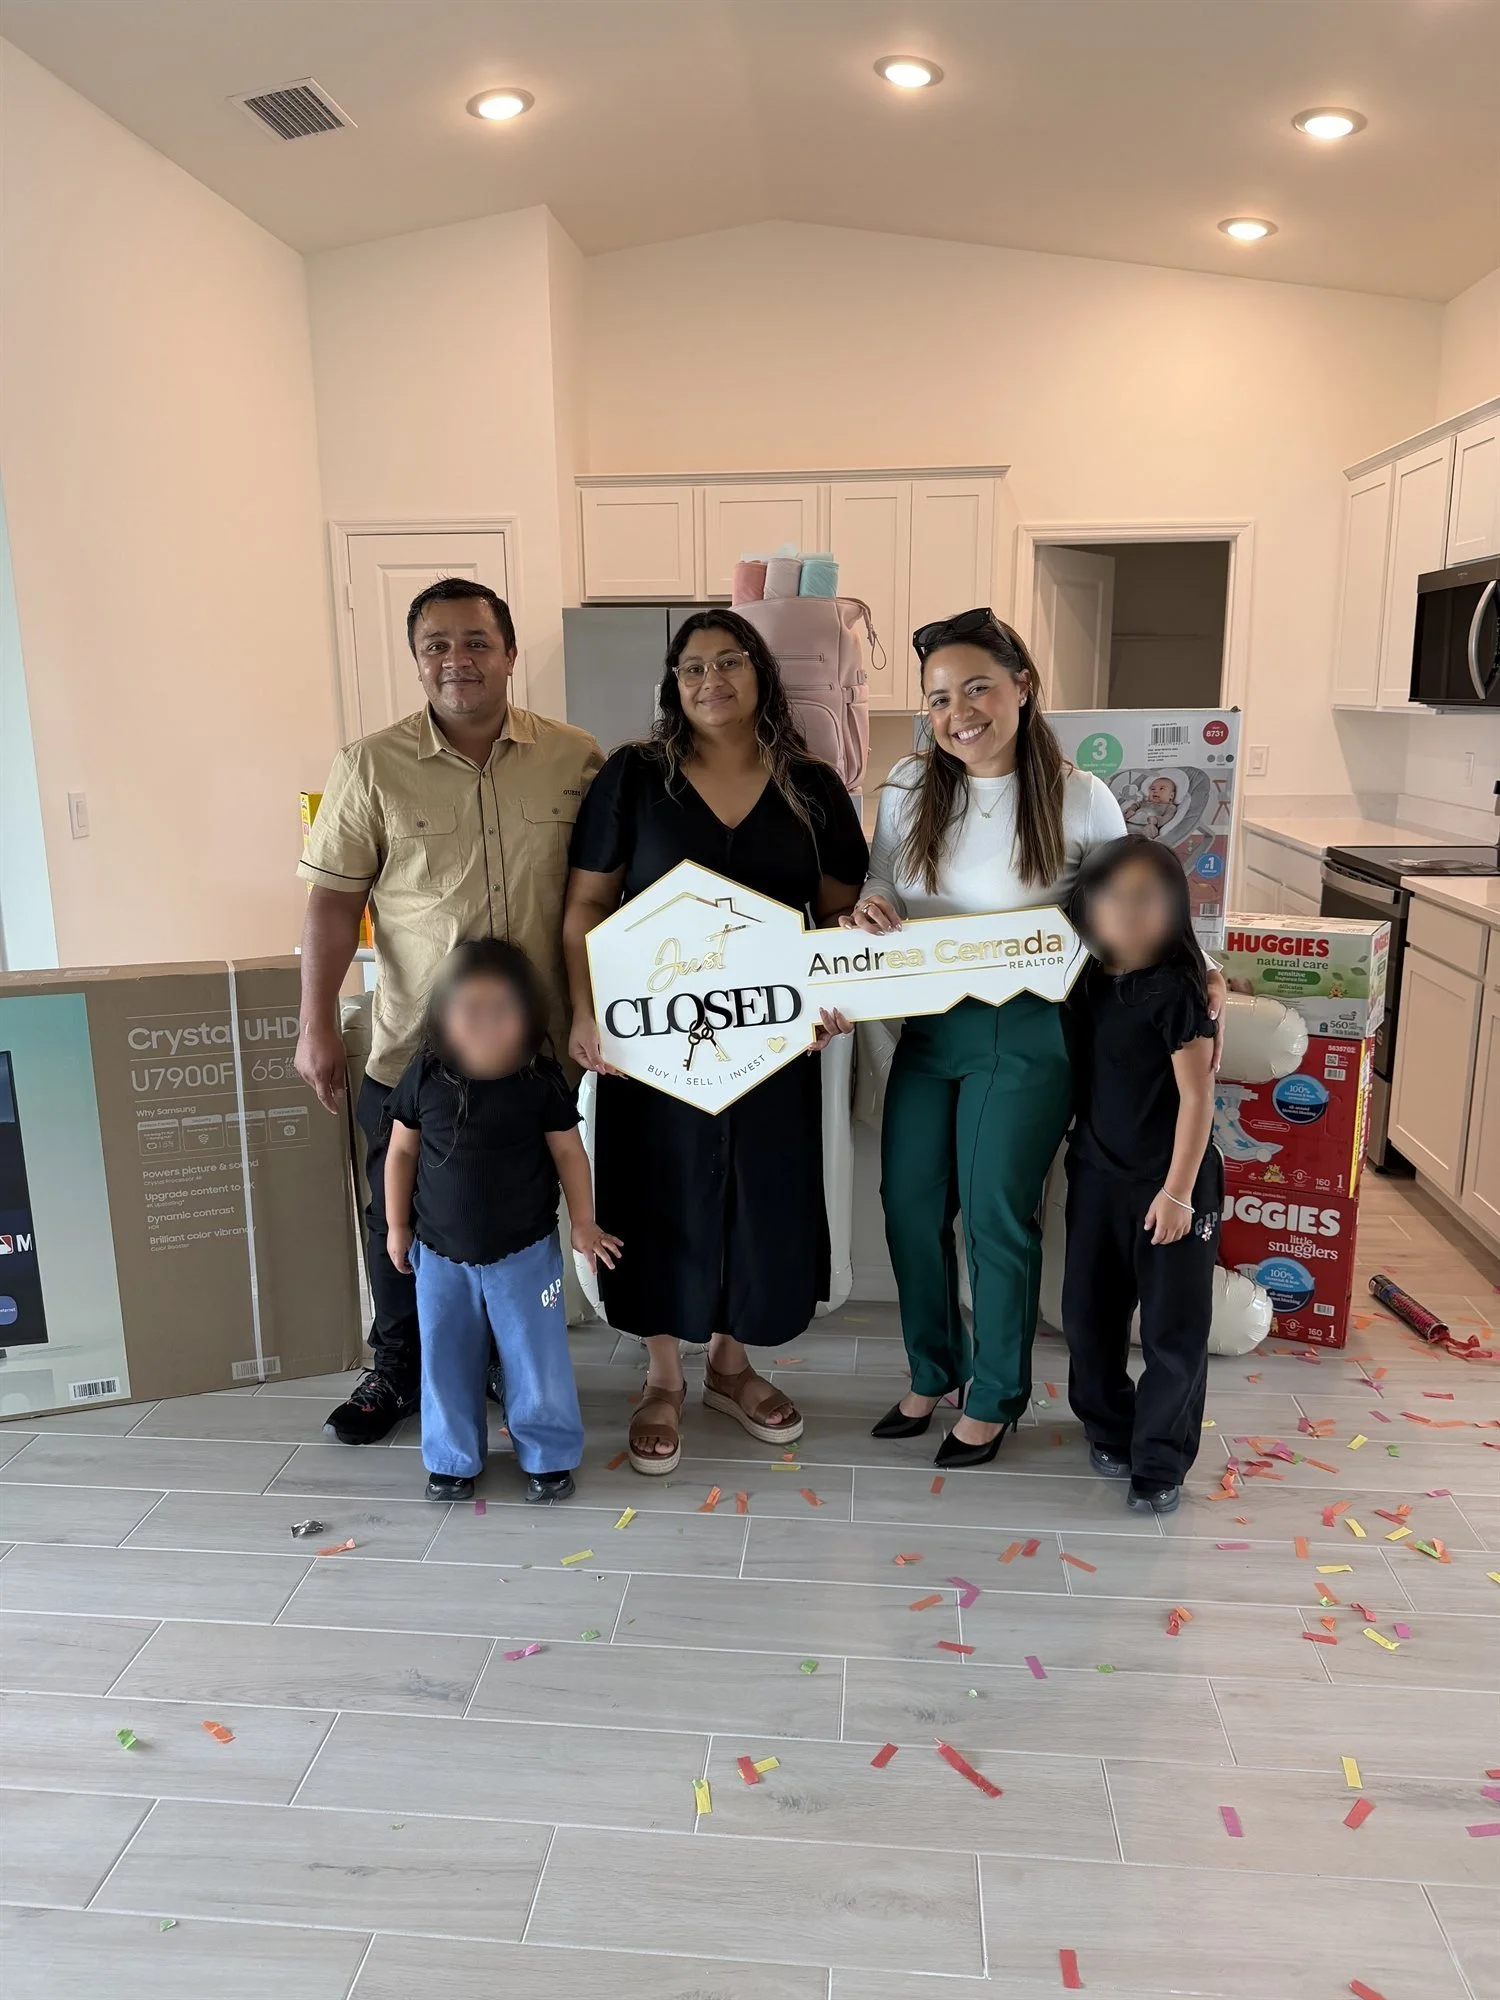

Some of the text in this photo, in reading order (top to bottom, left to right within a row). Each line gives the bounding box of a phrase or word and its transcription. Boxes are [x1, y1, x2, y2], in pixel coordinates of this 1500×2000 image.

[1206, 730, 1224, 738] 8731
[1092, 737, 1108, 761] 3
[808, 929, 1063, 977] Andrea Cerrada
[1226, 931, 1330, 958] HUGGIES
[646, 923, 752, 993] Just
[1009, 956, 1065, 969] REALTOR
[1256, 956, 1329, 970] natural care
[604, 984, 802, 1039] CLOSED
[1330, 1020, 1348, 1029] 560
[127, 1016, 300, 1056] Crysta UHD
[131, 1062, 235, 1092] U7900F
[647, 1064, 670, 1079] BUY
[686, 1077, 713, 1086] SELL
[730, 1054, 766, 1081] INVEST
[1290, 1085, 1311, 1094] 100%
[136, 1105, 196, 1118] Why Samsung
[142, 1168, 180, 1179] Powers
[182, 1164, 217, 1177] picture
[219, 1162, 227, 1171] &
[1315, 1178, 1331, 1187] 160
[1337, 1174, 1343, 1188] 1
[144, 1189, 189, 1202] Upgrade
[190, 1183, 229, 1196] content
[231, 1183, 241, 1192] to
[147, 1206, 235, 1224] Dynamic contrast
[1194, 1211, 1218, 1236] GAP
[1221, 1195, 1341, 1237] UGGIES
[149, 1233, 185, 1245] Brilliant
[187, 1230, 212, 1241] color
[1289, 1234, 1313, 1246] little
[1267, 1240, 1339, 1260] snugglers
[1270, 1269, 1294, 1280] 100%
[541, 1278, 562, 1308] GAP
[1308, 1327, 1323, 1336] 160
[1329, 1324, 1335, 1338] 1
